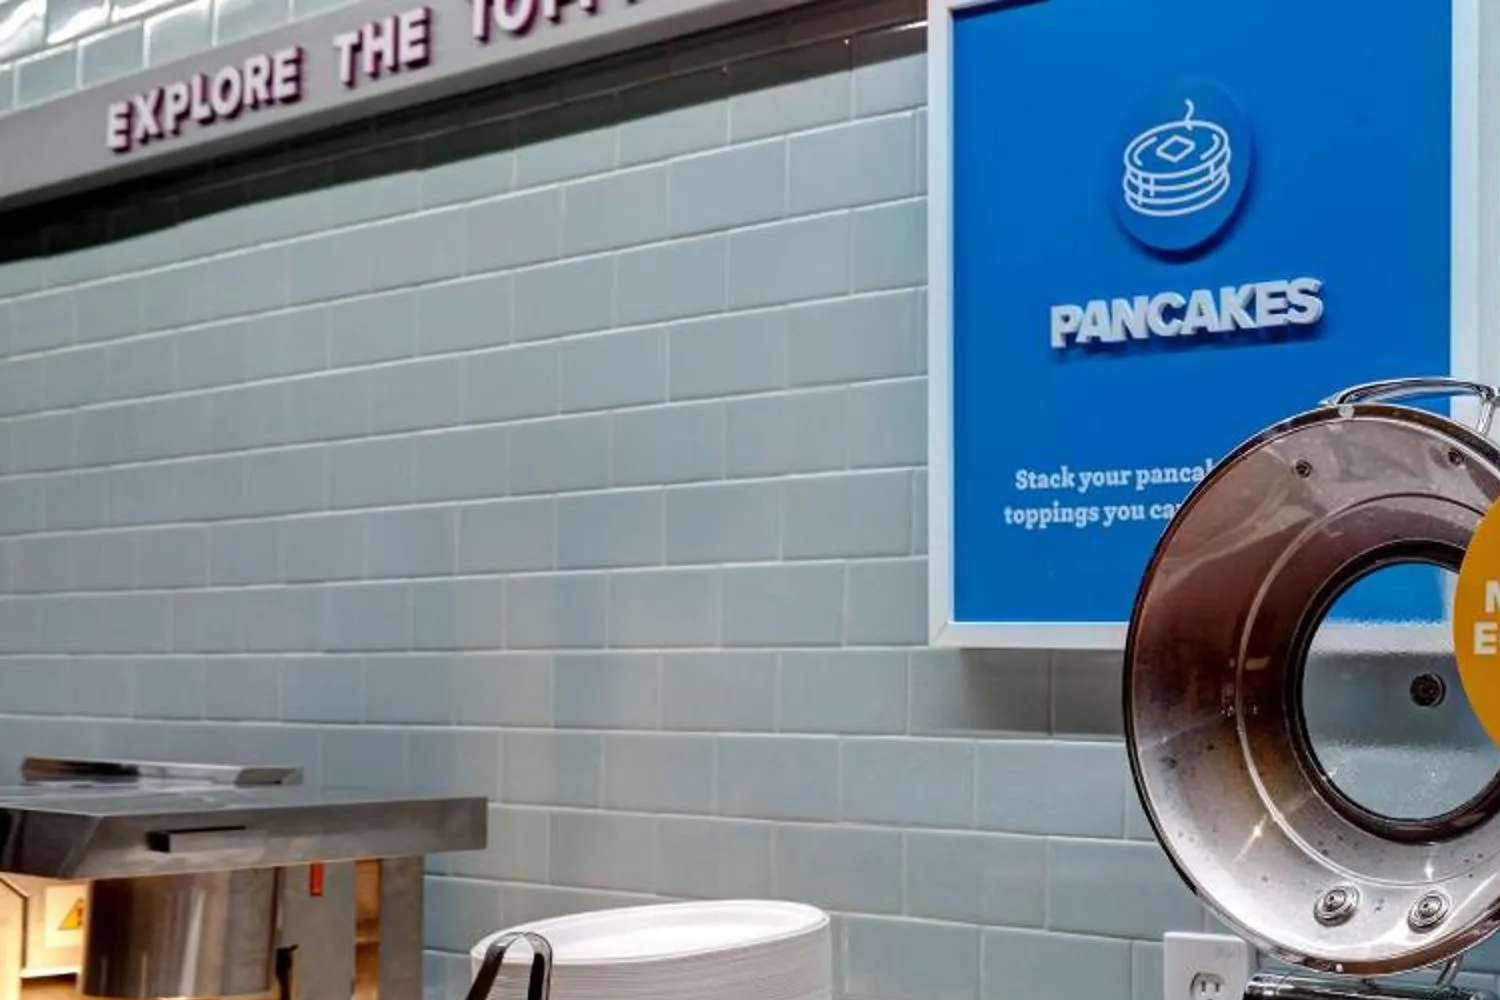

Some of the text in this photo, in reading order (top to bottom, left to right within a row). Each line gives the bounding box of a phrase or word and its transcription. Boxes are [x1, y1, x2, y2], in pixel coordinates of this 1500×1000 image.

[106, 48, 304, 152] EXPLORE
[333, 6, 431, 84] THE
[1051, 278, 1325, 348] PANCAKES
[1015, 466, 1074, 491] Stack
[1078, 469, 1132, 493] your
[1003, 501, 1100, 531] toppings
[1103, 504, 1145, 528] you
